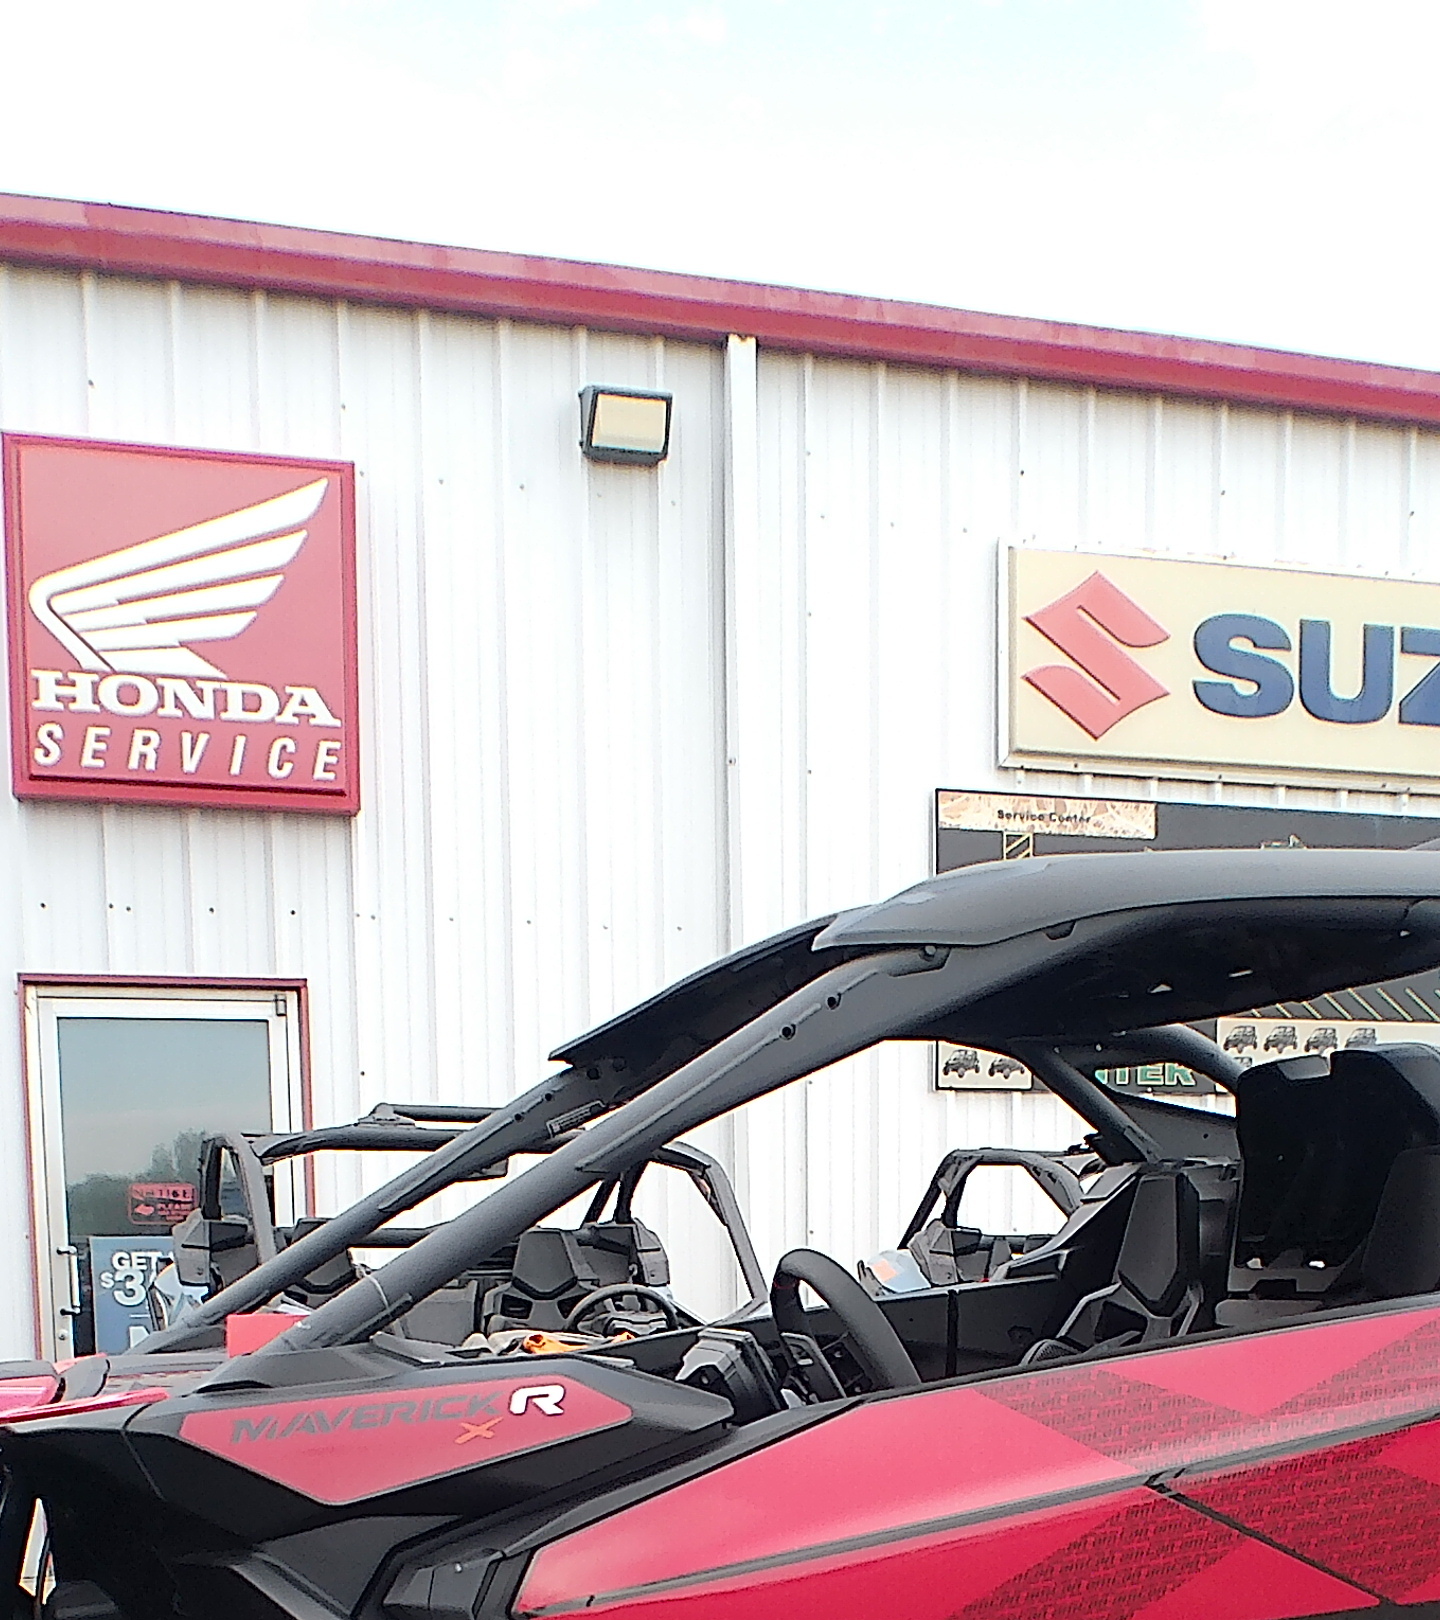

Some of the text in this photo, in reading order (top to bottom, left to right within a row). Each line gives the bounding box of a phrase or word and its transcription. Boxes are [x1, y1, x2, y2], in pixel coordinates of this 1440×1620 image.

[30, 668, 342, 727] HONDA
[34, 722, 342, 781] SERVICE
[112, 1251, 163, 1271] GET
[230, 1384, 565, 1444] MAVERICK R
